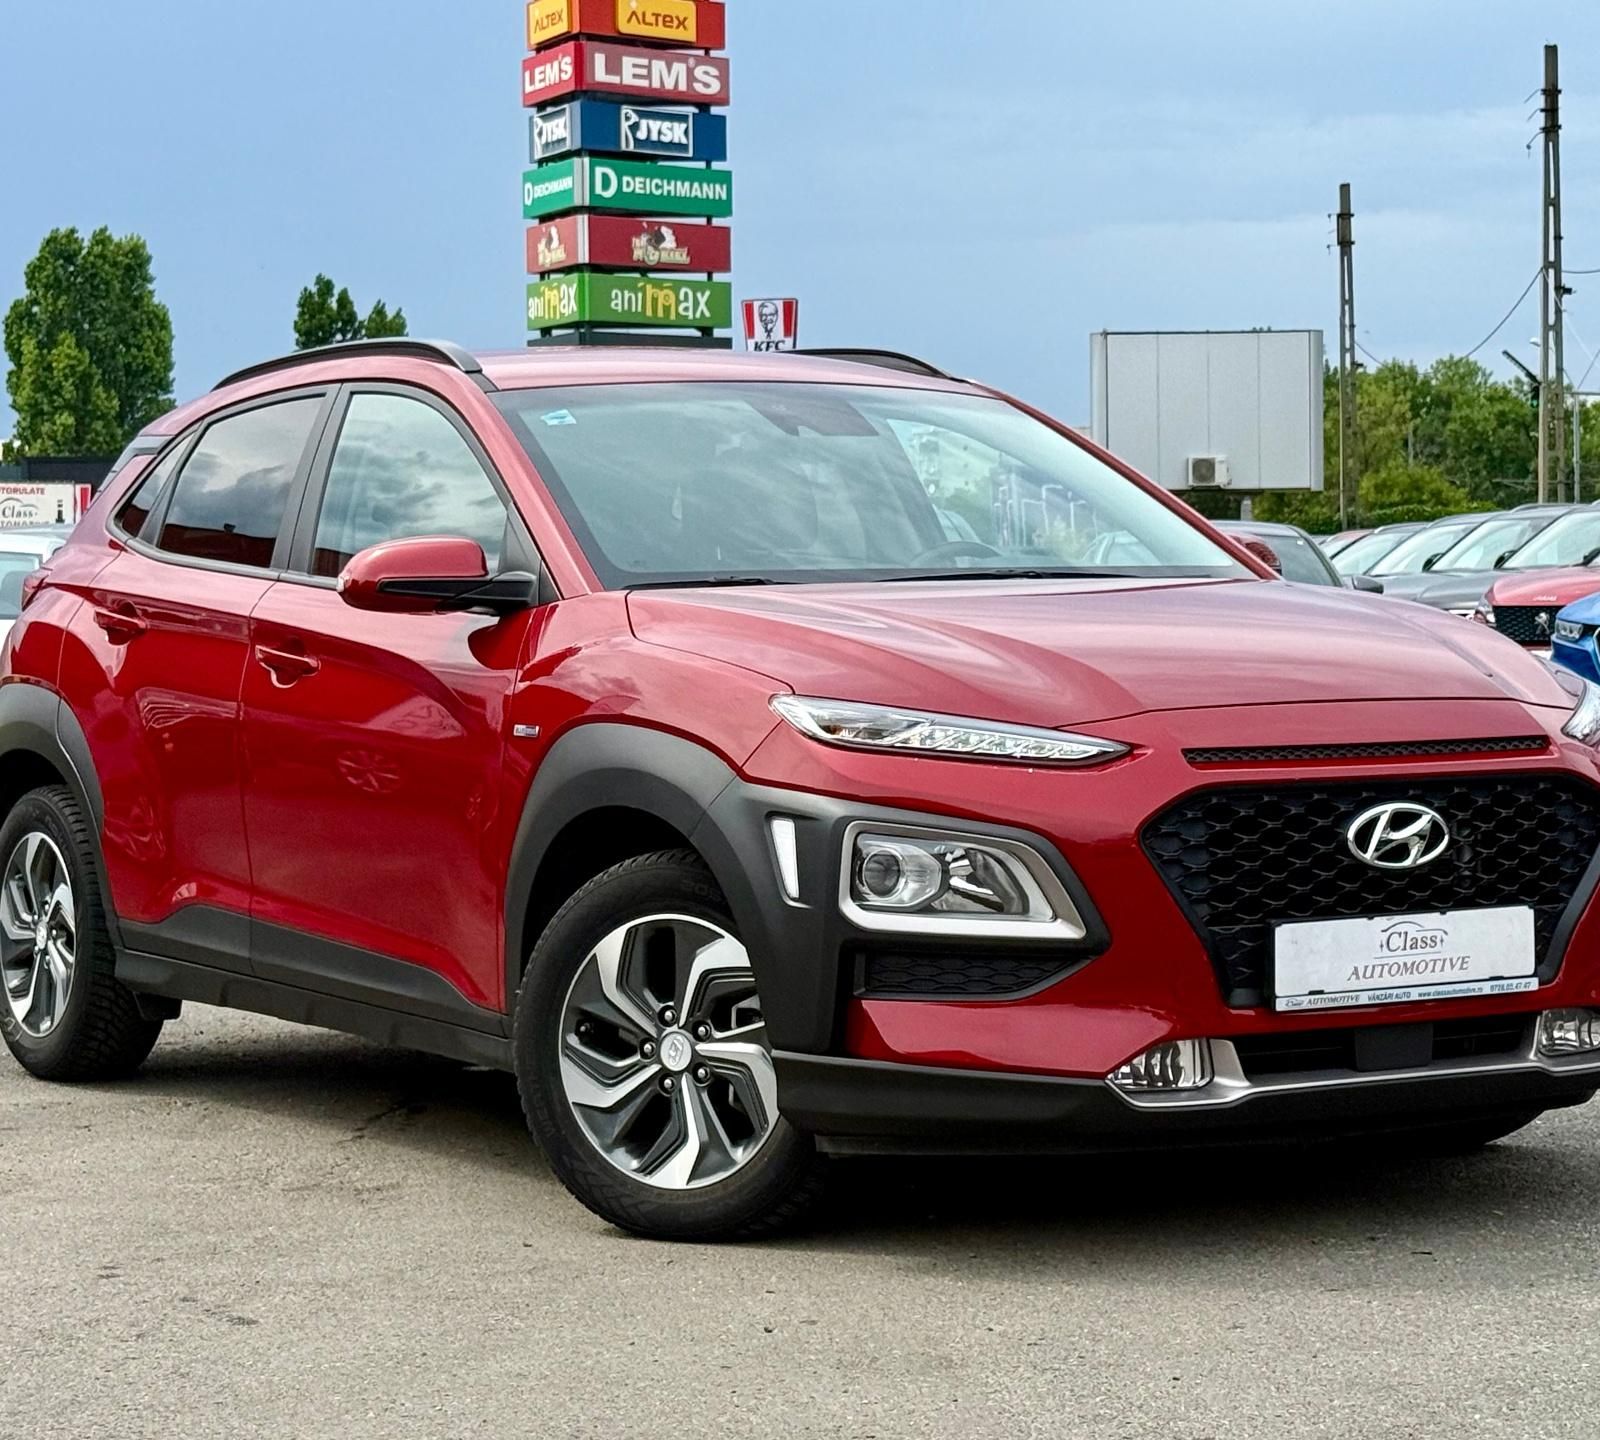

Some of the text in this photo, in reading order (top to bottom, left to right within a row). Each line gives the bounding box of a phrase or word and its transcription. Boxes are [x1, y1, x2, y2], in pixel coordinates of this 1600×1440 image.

[594, 53, 721, 95] LEM'S
[637, 119, 688, 144] JYSK
[622, 176, 727, 200] DEICHMANN
[611, 282, 711, 320] animax
[754, 340, 785, 352] KFC
[2, 505, 33, 519] Class
[1386, 931, 1438, 953] Class
[1347, 955, 1471, 982] AUTOMOTIVE
[1306, 995, 1360, 1006] AUTOMOTIVE
